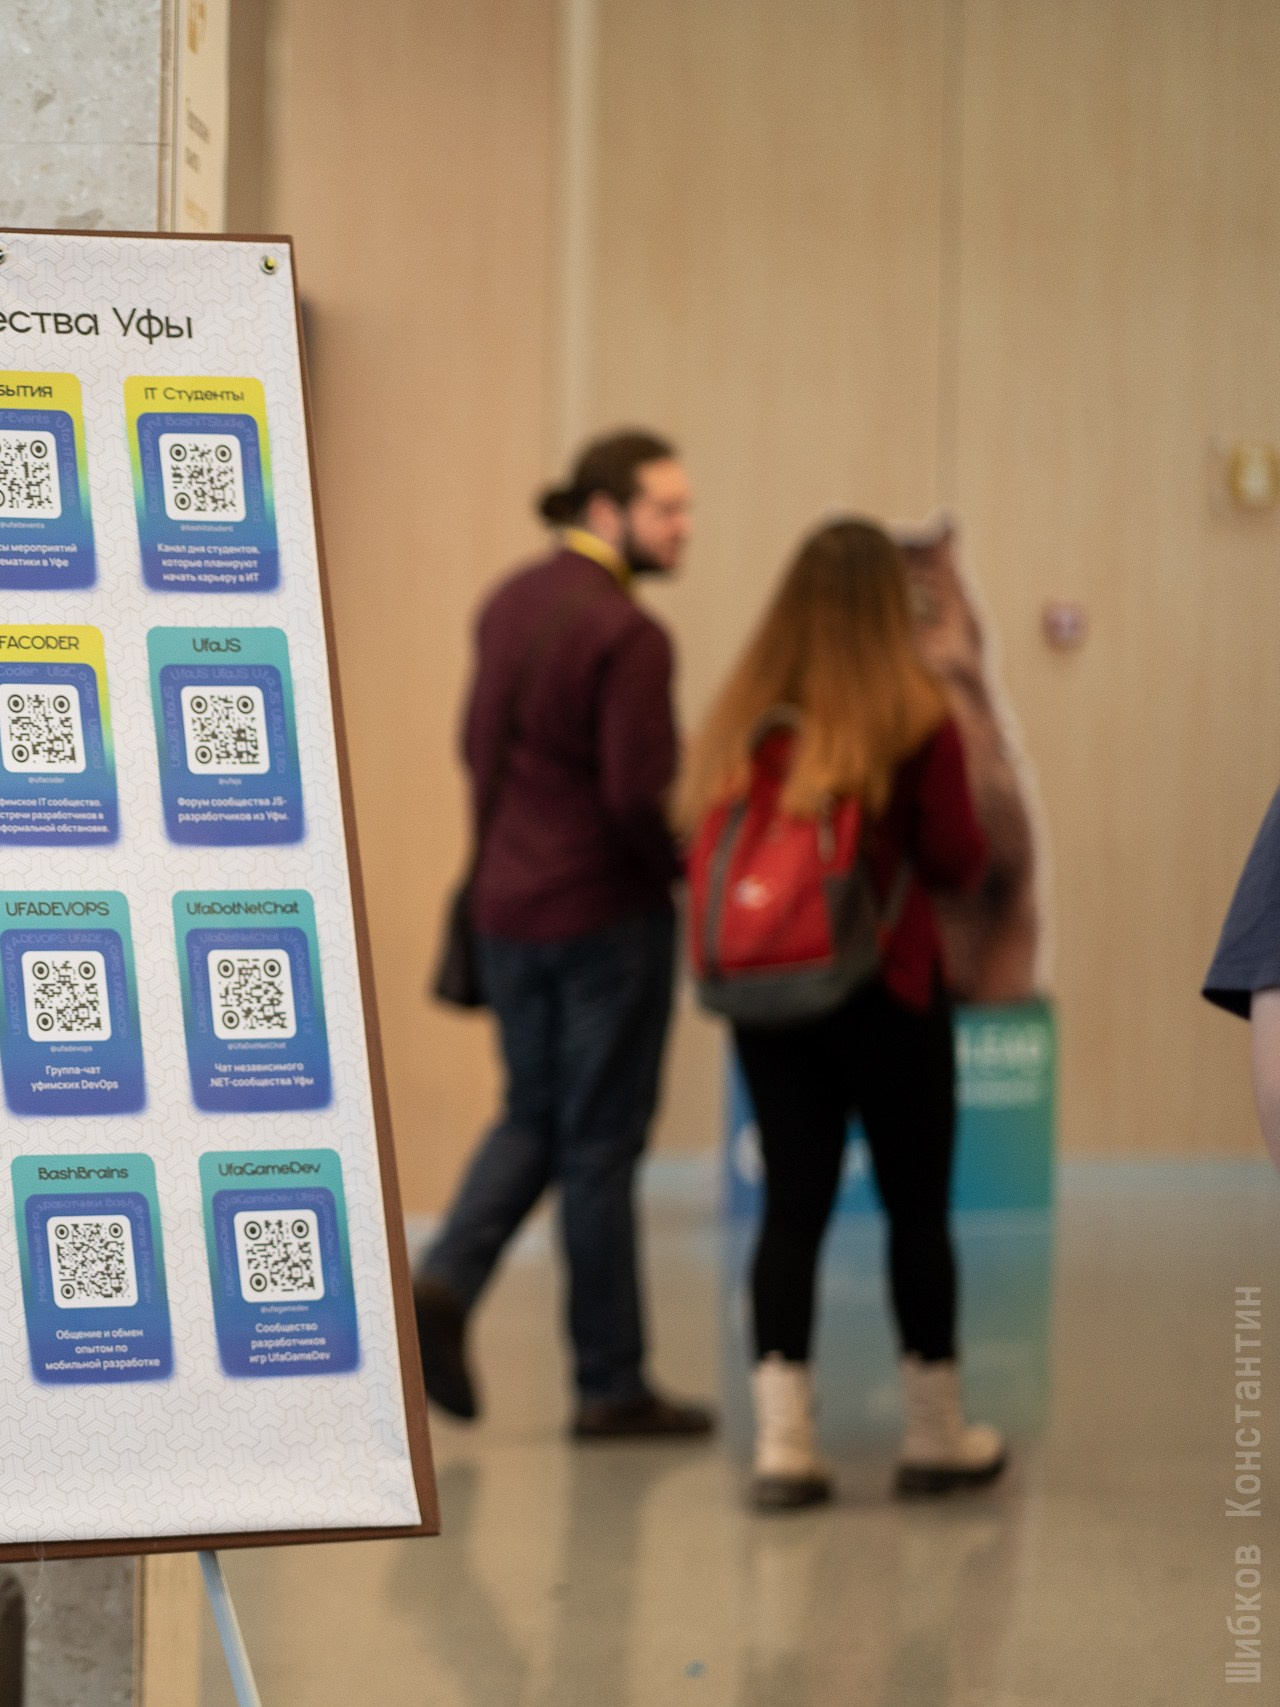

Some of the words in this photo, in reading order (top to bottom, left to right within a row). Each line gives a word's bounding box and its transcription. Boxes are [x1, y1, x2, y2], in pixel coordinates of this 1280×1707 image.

[112, 308, 194, 345] Уфы
[144, 388, 157, 400] IT
[164, 388, 244, 402] Студенты
[11, 542, 77, 554] мероприятий
[50, 557, 69, 569] Уфе
[161, 559, 202, 569] которые
[204, 560, 258, 570] планируют
[162, 573, 197, 582] начать
[197, 573, 236, 584] карьеру
[192, 638, 241, 653] UfaJS
[48, 798, 102, 809] сообщество.
[177, 797, 210, 808] Форум
[211, 798, 270, 809] сообщества
[31, 811, 96, 822] разработчиков
[178, 812, 251, 823] разработчиков
[57, 824, 110, 833] обстановке.
[6, 901, 109, 917] UFADEVOPS
[186, 901, 299, 916] UfaDotNetChat
[45, 1065, 101, 1077] Группа-чат
[214, 1062, 232, 1072] Чат
[234, 1062, 304, 1072] независимого
[31, 1080, 80, 1092] уфимских
[81, 1080, 119, 1092] DevOps
[294, 1076, 314, 1087] Уфы
[38, 1166, 129, 1181] BashBrains
[219, 1161, 321, 1177] UfaGameDev
[255, 1322, 318, 1334] Сообщество
[56, 1329, 102, 1340] Общение
[112, 1329, 144, 1338] обмен
[75, 1344, 114, 1354] опытом
[115, 1344, 128, 1353] по
[251, 1337, 326, 1350] разработчиков
[45, 1359, 101, 1370] мобильной
[103, 1358, 161, 1370] разработке
[249, 1354, 267, 1365] игр
[268, 1351, 331, 1363] UfaGameDev
